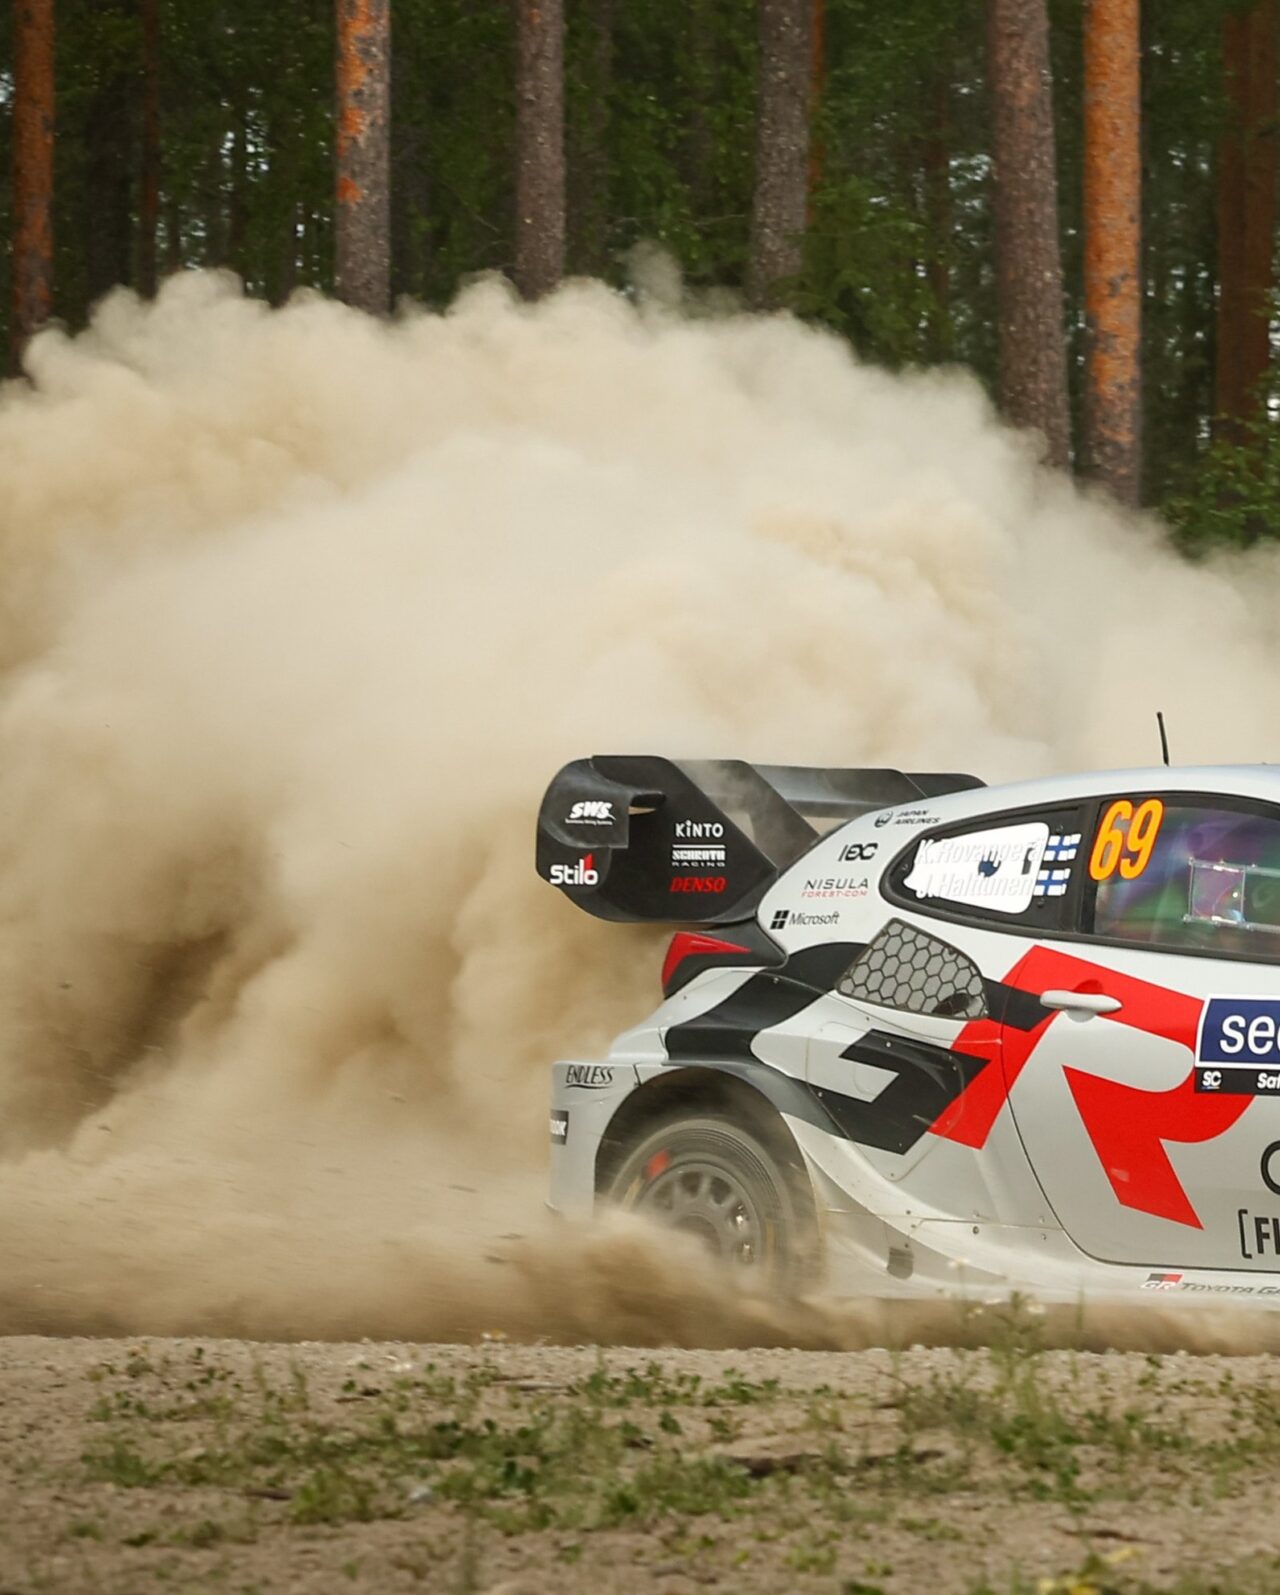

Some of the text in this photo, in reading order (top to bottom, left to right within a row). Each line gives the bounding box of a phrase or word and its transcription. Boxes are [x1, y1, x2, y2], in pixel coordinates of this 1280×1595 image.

[1089, 797, 1164, 881] 69
[550, 859, 599, 885] Stilo
[670, 876, 728, 893] DENSO
[803, 878, 869, 890] NISULA
[788, 911, 840, 926] Microsoft
[1202, 1070, 1222, 1088] SC
